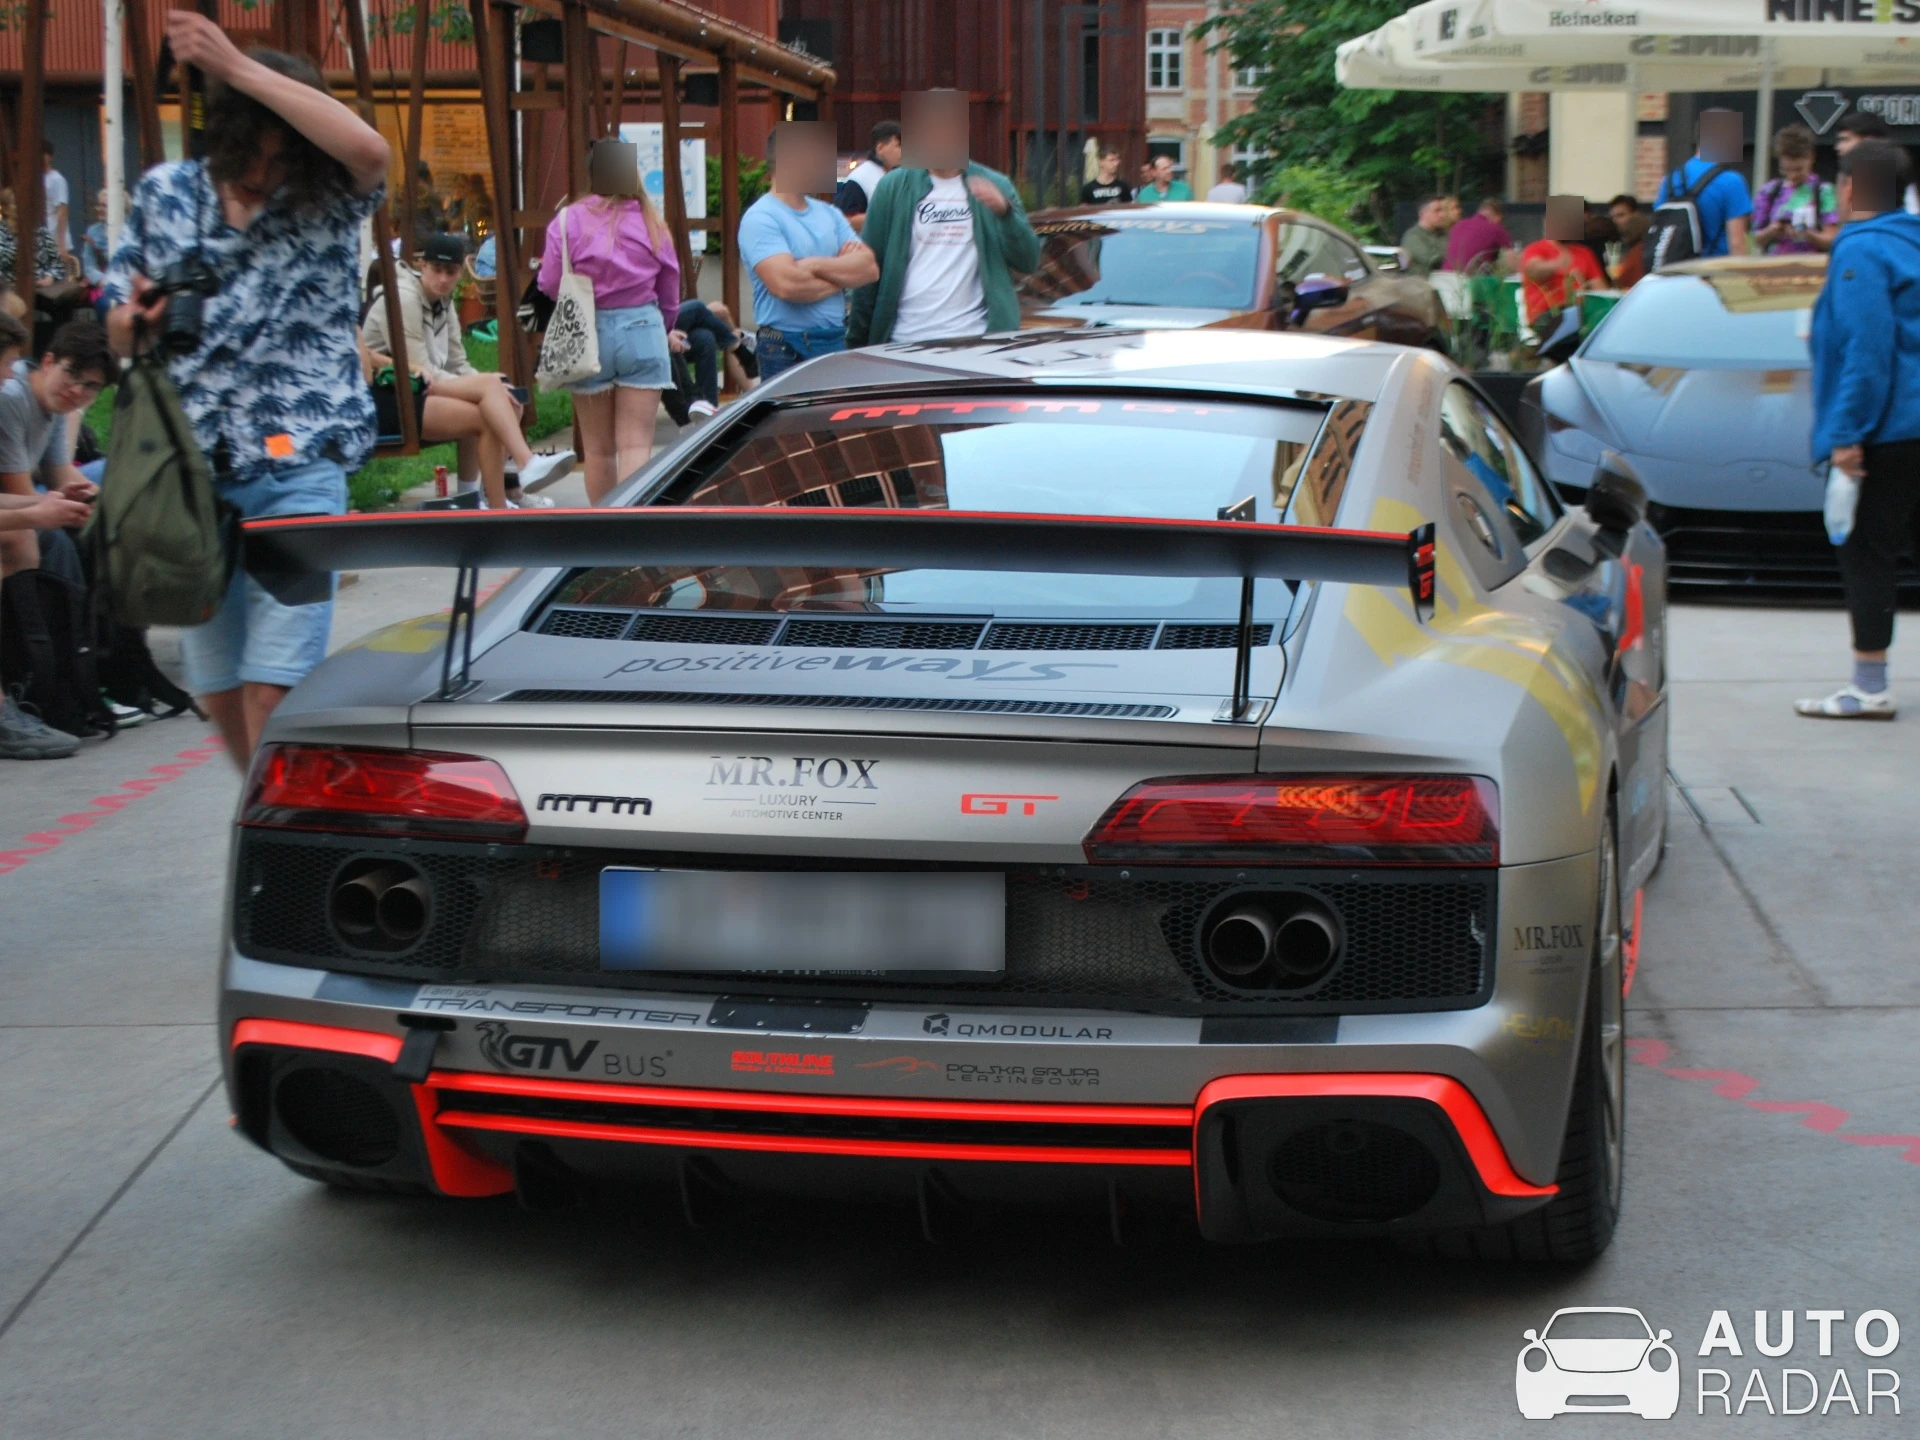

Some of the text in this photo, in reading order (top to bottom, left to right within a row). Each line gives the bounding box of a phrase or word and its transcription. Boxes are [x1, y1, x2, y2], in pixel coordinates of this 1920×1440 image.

[1549, 11, 1639, 27] Heineken
[603, 650, 1118, 682] positiveways
[705, 756, 880, 789] MR.FOX
[759, 794, 818, 807] LUXURY
[961, 793, 1060, 816] GT
[731, 808, 843, 821] AUTOMOTIVE CENTER
[1513, 924, 1584, 951] MR.FOX
[456, 988, 492, 998] your
[419, 997, 701, 1026] TRANSPORTER
[957, 1024, 1113, 1039] QMODULAR
[503, 1034, 599, 1072] GTV
[731, 1051, 834, 1068] SOUTHLINE
[946, 1063, 1099, 1078] POLSKA GRUPA
[946, 1074, 1100, 1086] LEASINGOWA
